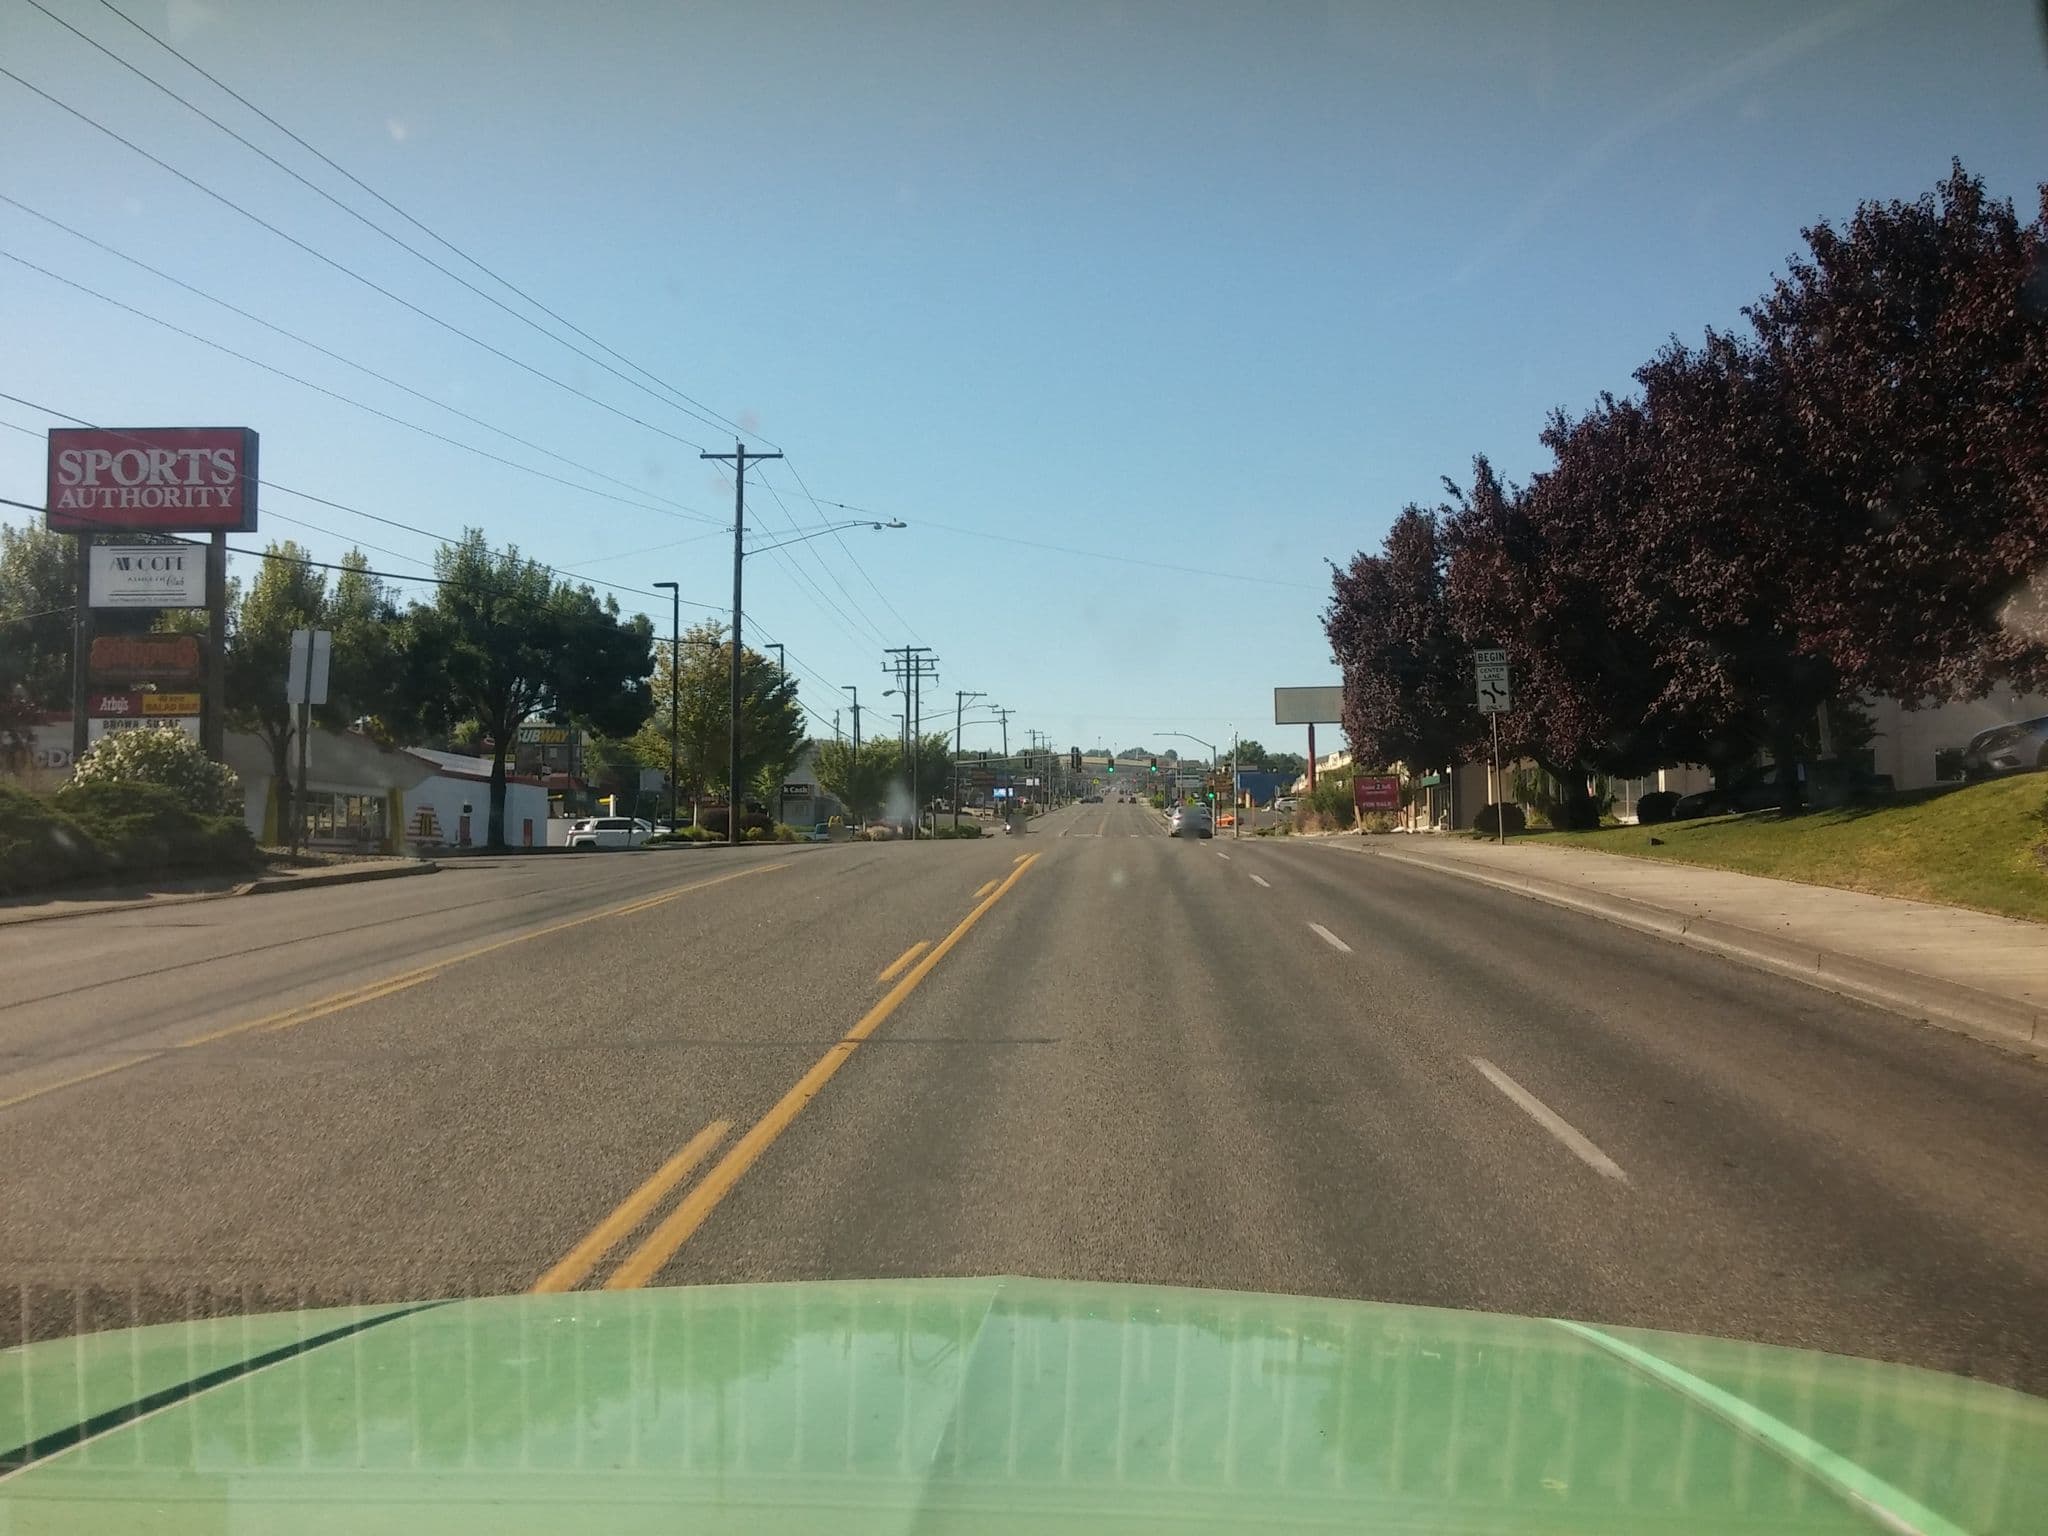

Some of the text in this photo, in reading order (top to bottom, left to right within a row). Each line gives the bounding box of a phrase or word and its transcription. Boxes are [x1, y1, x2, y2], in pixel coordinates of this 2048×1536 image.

[57, 448, 236, 486] SPORTS
[57, 487, 235, 509] AUTHORITY
[1478, 653, 1505, 662] BEGIN
[99, 696, 129, 714] Arby's
[103, 719, 139, 729] BROWN
[518, 728, 569, 743] SUBWAY
